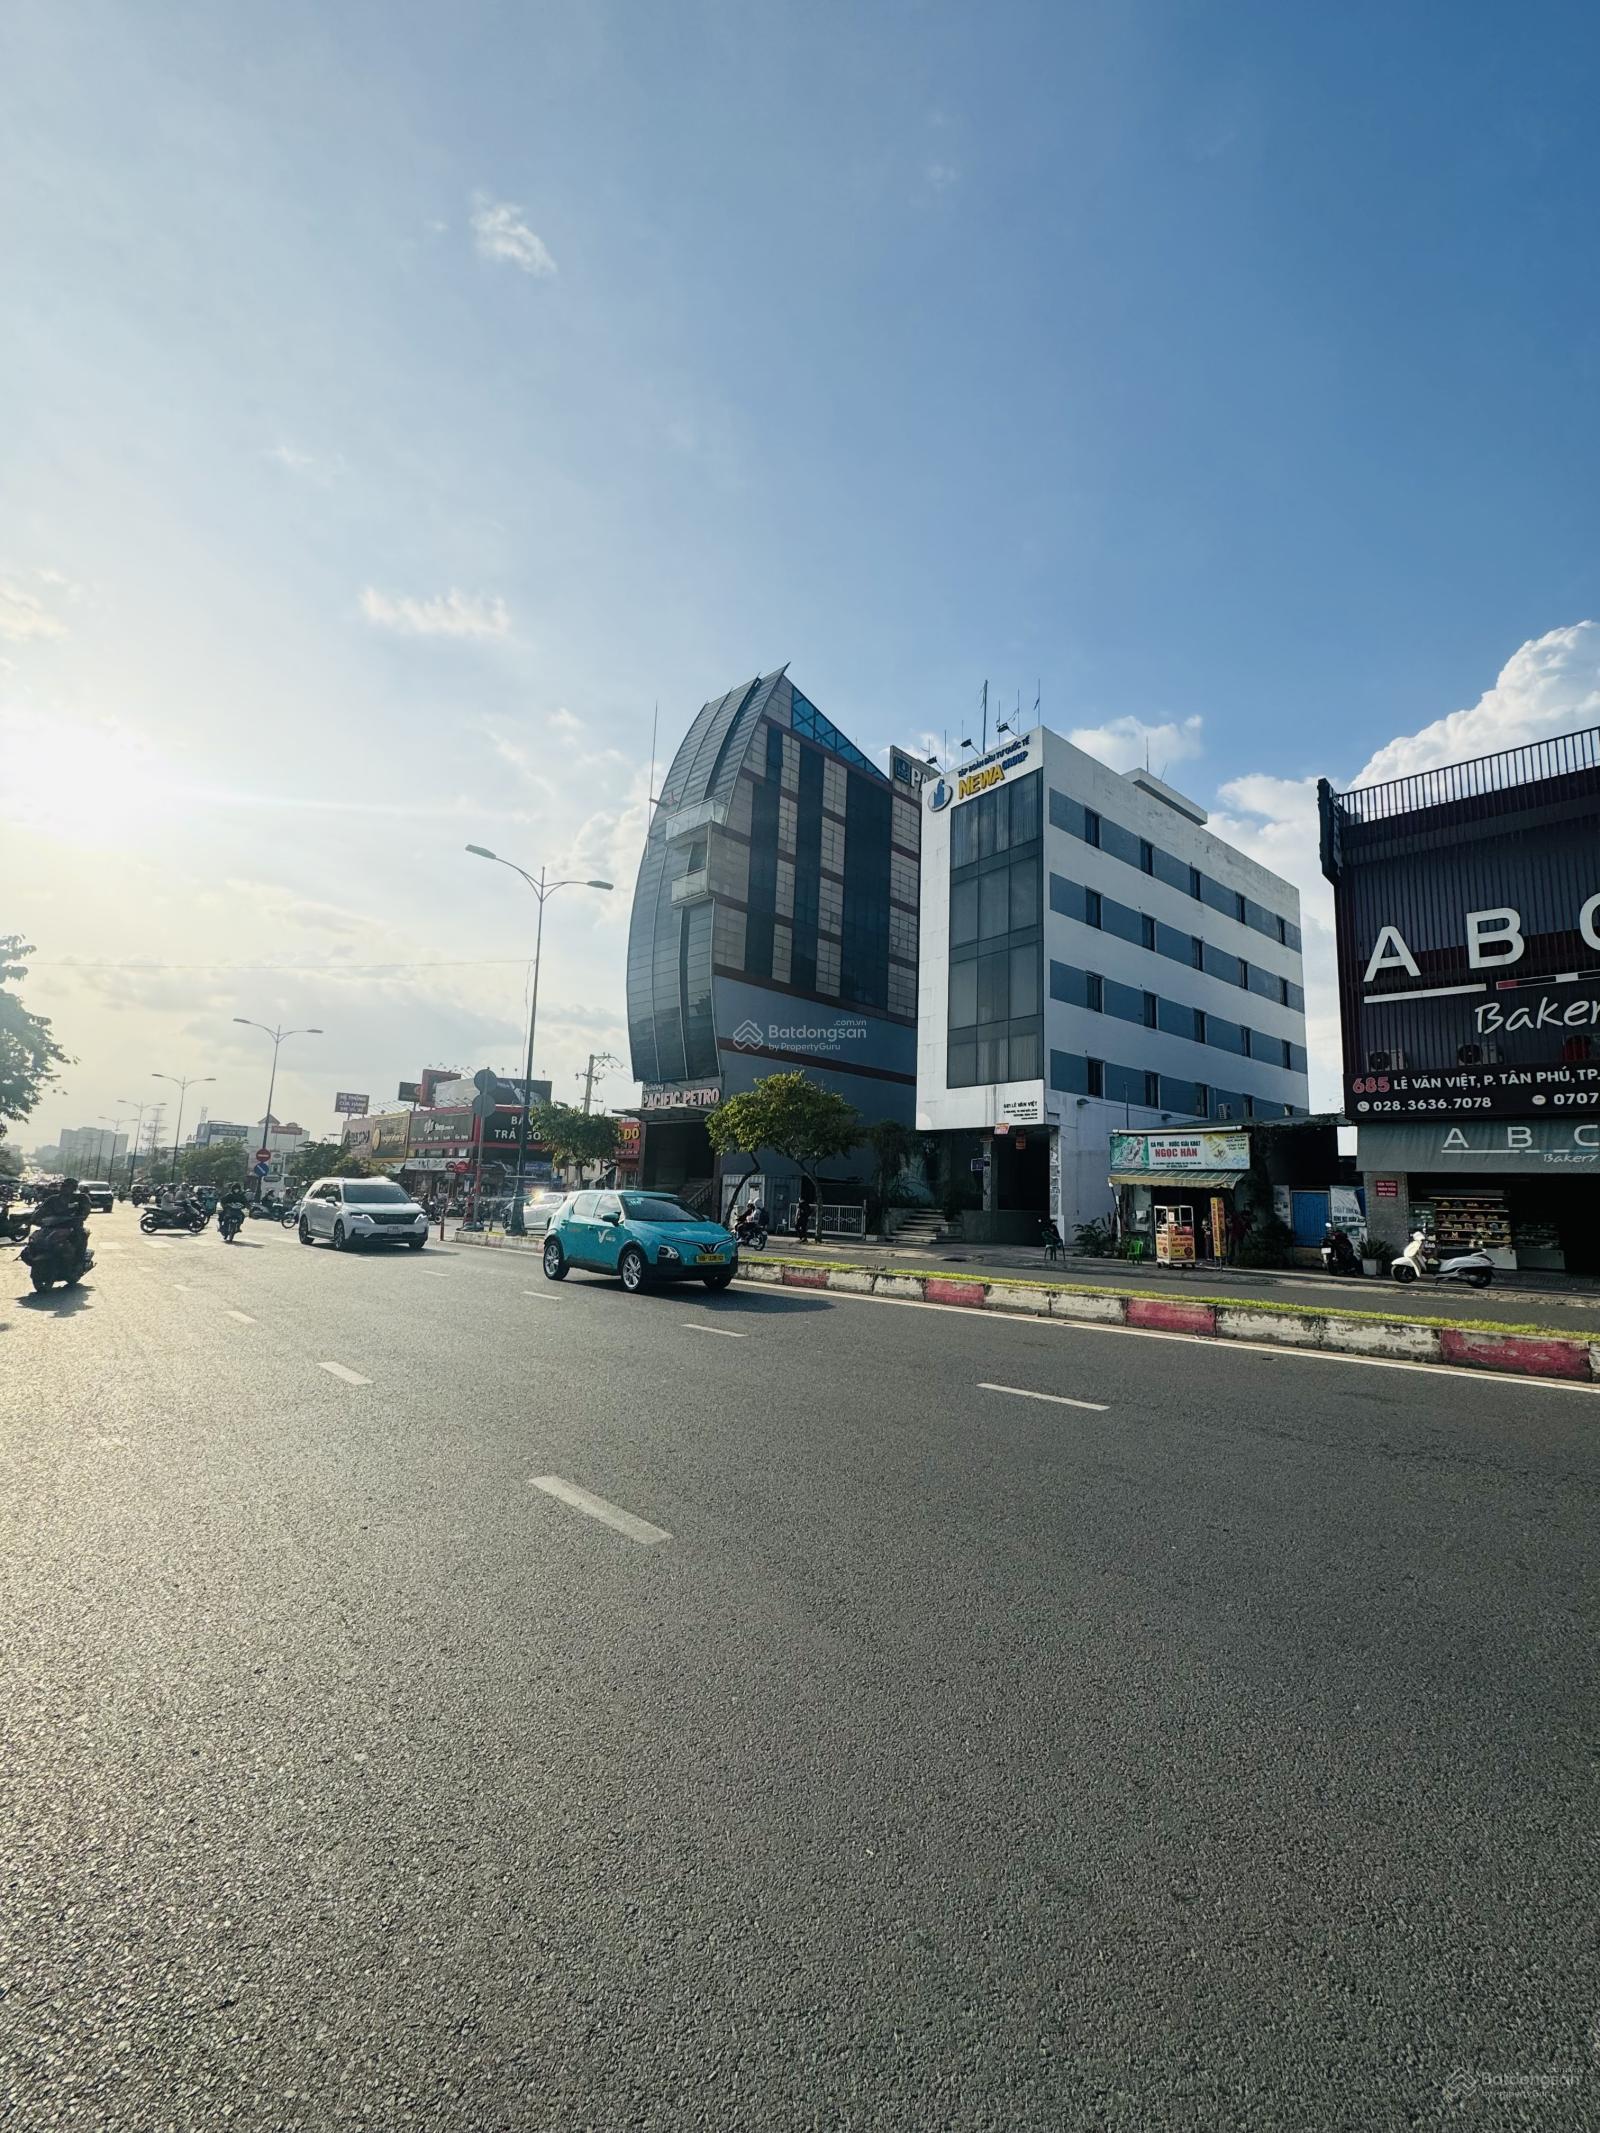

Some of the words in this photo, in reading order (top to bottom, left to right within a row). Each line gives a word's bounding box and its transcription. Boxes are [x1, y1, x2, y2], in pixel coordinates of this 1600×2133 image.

[1001, 750, 1029, 771] GROUP
[958, 763, 1006, 800] NEWA
[1352, 1076, 1391, 1094] 685
[1393, 1075, 1409, 1090] LÊ
[1412, 1074, 1442, 1089] VĂN
[1444, 1072, 1481, 1090] VIỆT,
[1483, 1074, 1497, 1086] P.
[1499, 1069, 1532, 1085] TÂN
[1536, 1065, 1576, 1084] PHÚ,
[642, 1091, 681, 1109] PACIFIC
[681, 1087, 720, 1106] PETRO
[1373, 1096, 1492, 1112] 028.3636.7078
[494, 1127, 517, 1140] TRẢ
[1154, 1147, 1178, 1159] NGỌC
[1543, 1153, 1599, 1163] Bakery
